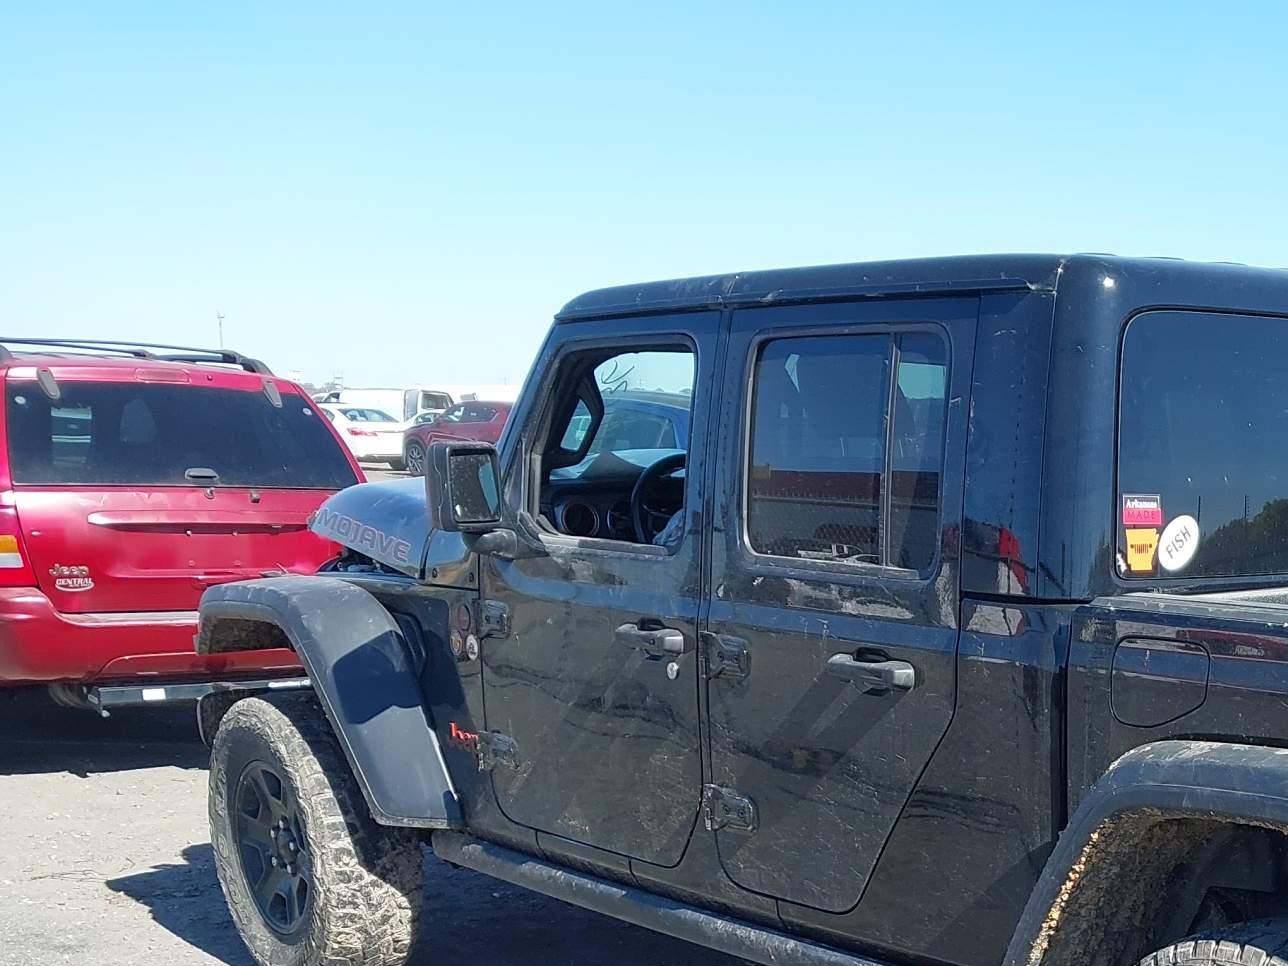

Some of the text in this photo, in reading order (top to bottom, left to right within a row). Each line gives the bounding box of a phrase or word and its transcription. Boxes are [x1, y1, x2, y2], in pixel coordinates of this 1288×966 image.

[1127, 510, 1156, 520] MADE
[317, 507, 412, 563] MOJAVE
[1165, 525, 1192, 559] FISH
[48, 563, 89, 577] Jeep
[56, 577, 92, 586] CENTRAL
